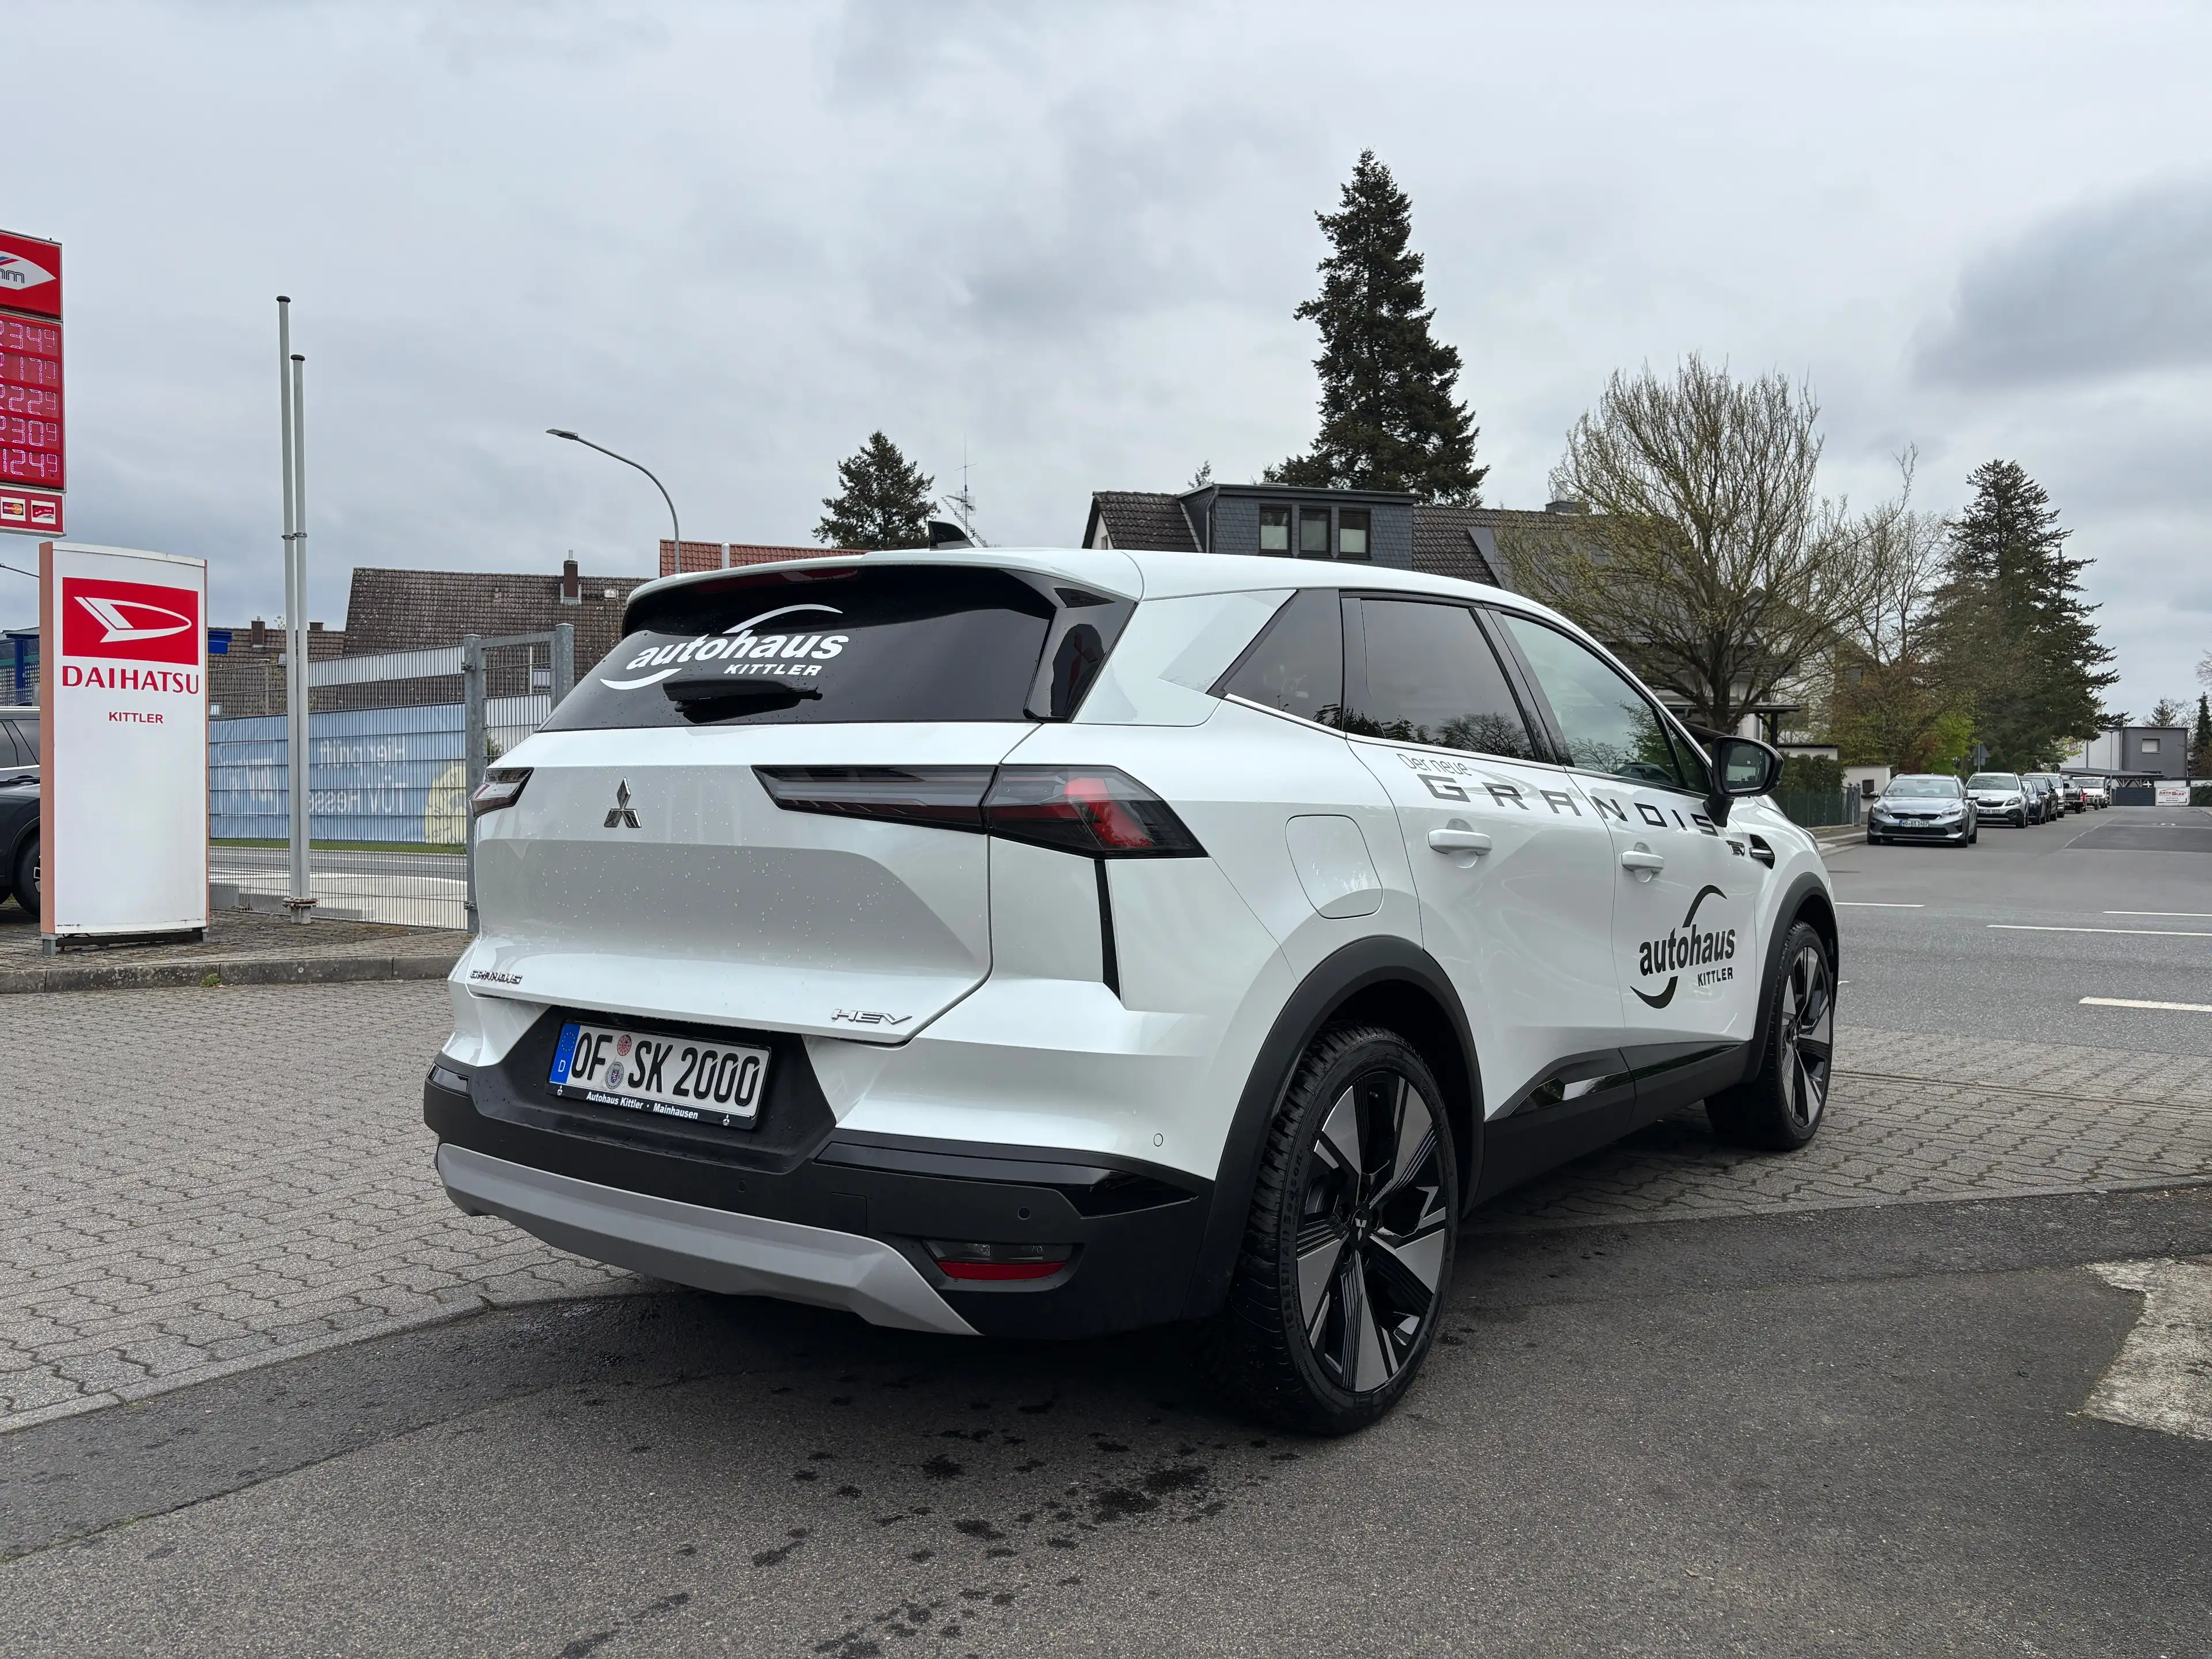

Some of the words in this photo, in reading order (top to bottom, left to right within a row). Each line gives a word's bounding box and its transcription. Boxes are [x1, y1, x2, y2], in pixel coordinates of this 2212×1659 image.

[0, 321, 55, 352] 349
[626, 630, 849, 670] autohaus
[62, 665, 199, 695] DAIHATSU
[724, 663, 822, 676] KITTLER
[108, 711, 164, 724] KITTLER
[1396, 753, 1431, 771] Der
[1429, 759, 1472, 777] neue
[1417, 774, 1719, 837] GRANDIS
[1639, 924, 1735, 976] autohaus
[470, 969, 523, 984] GRANDIS
[1698, 967, 1733, 987] KITTLER
[831, 1009, 912, 1025] HEV
[558, 1059, 566, 1073] D
[571, 1032, 613, 1081] OF
[628, 1040, 673, 1093] SK
[672, 1047, 760, 1107] 2000
[586, 1091, 619, 1105] Autohaus
[620, 1097, 643, 1109] Kittler
[653, 1103, 698, 1120] Mainhausen
